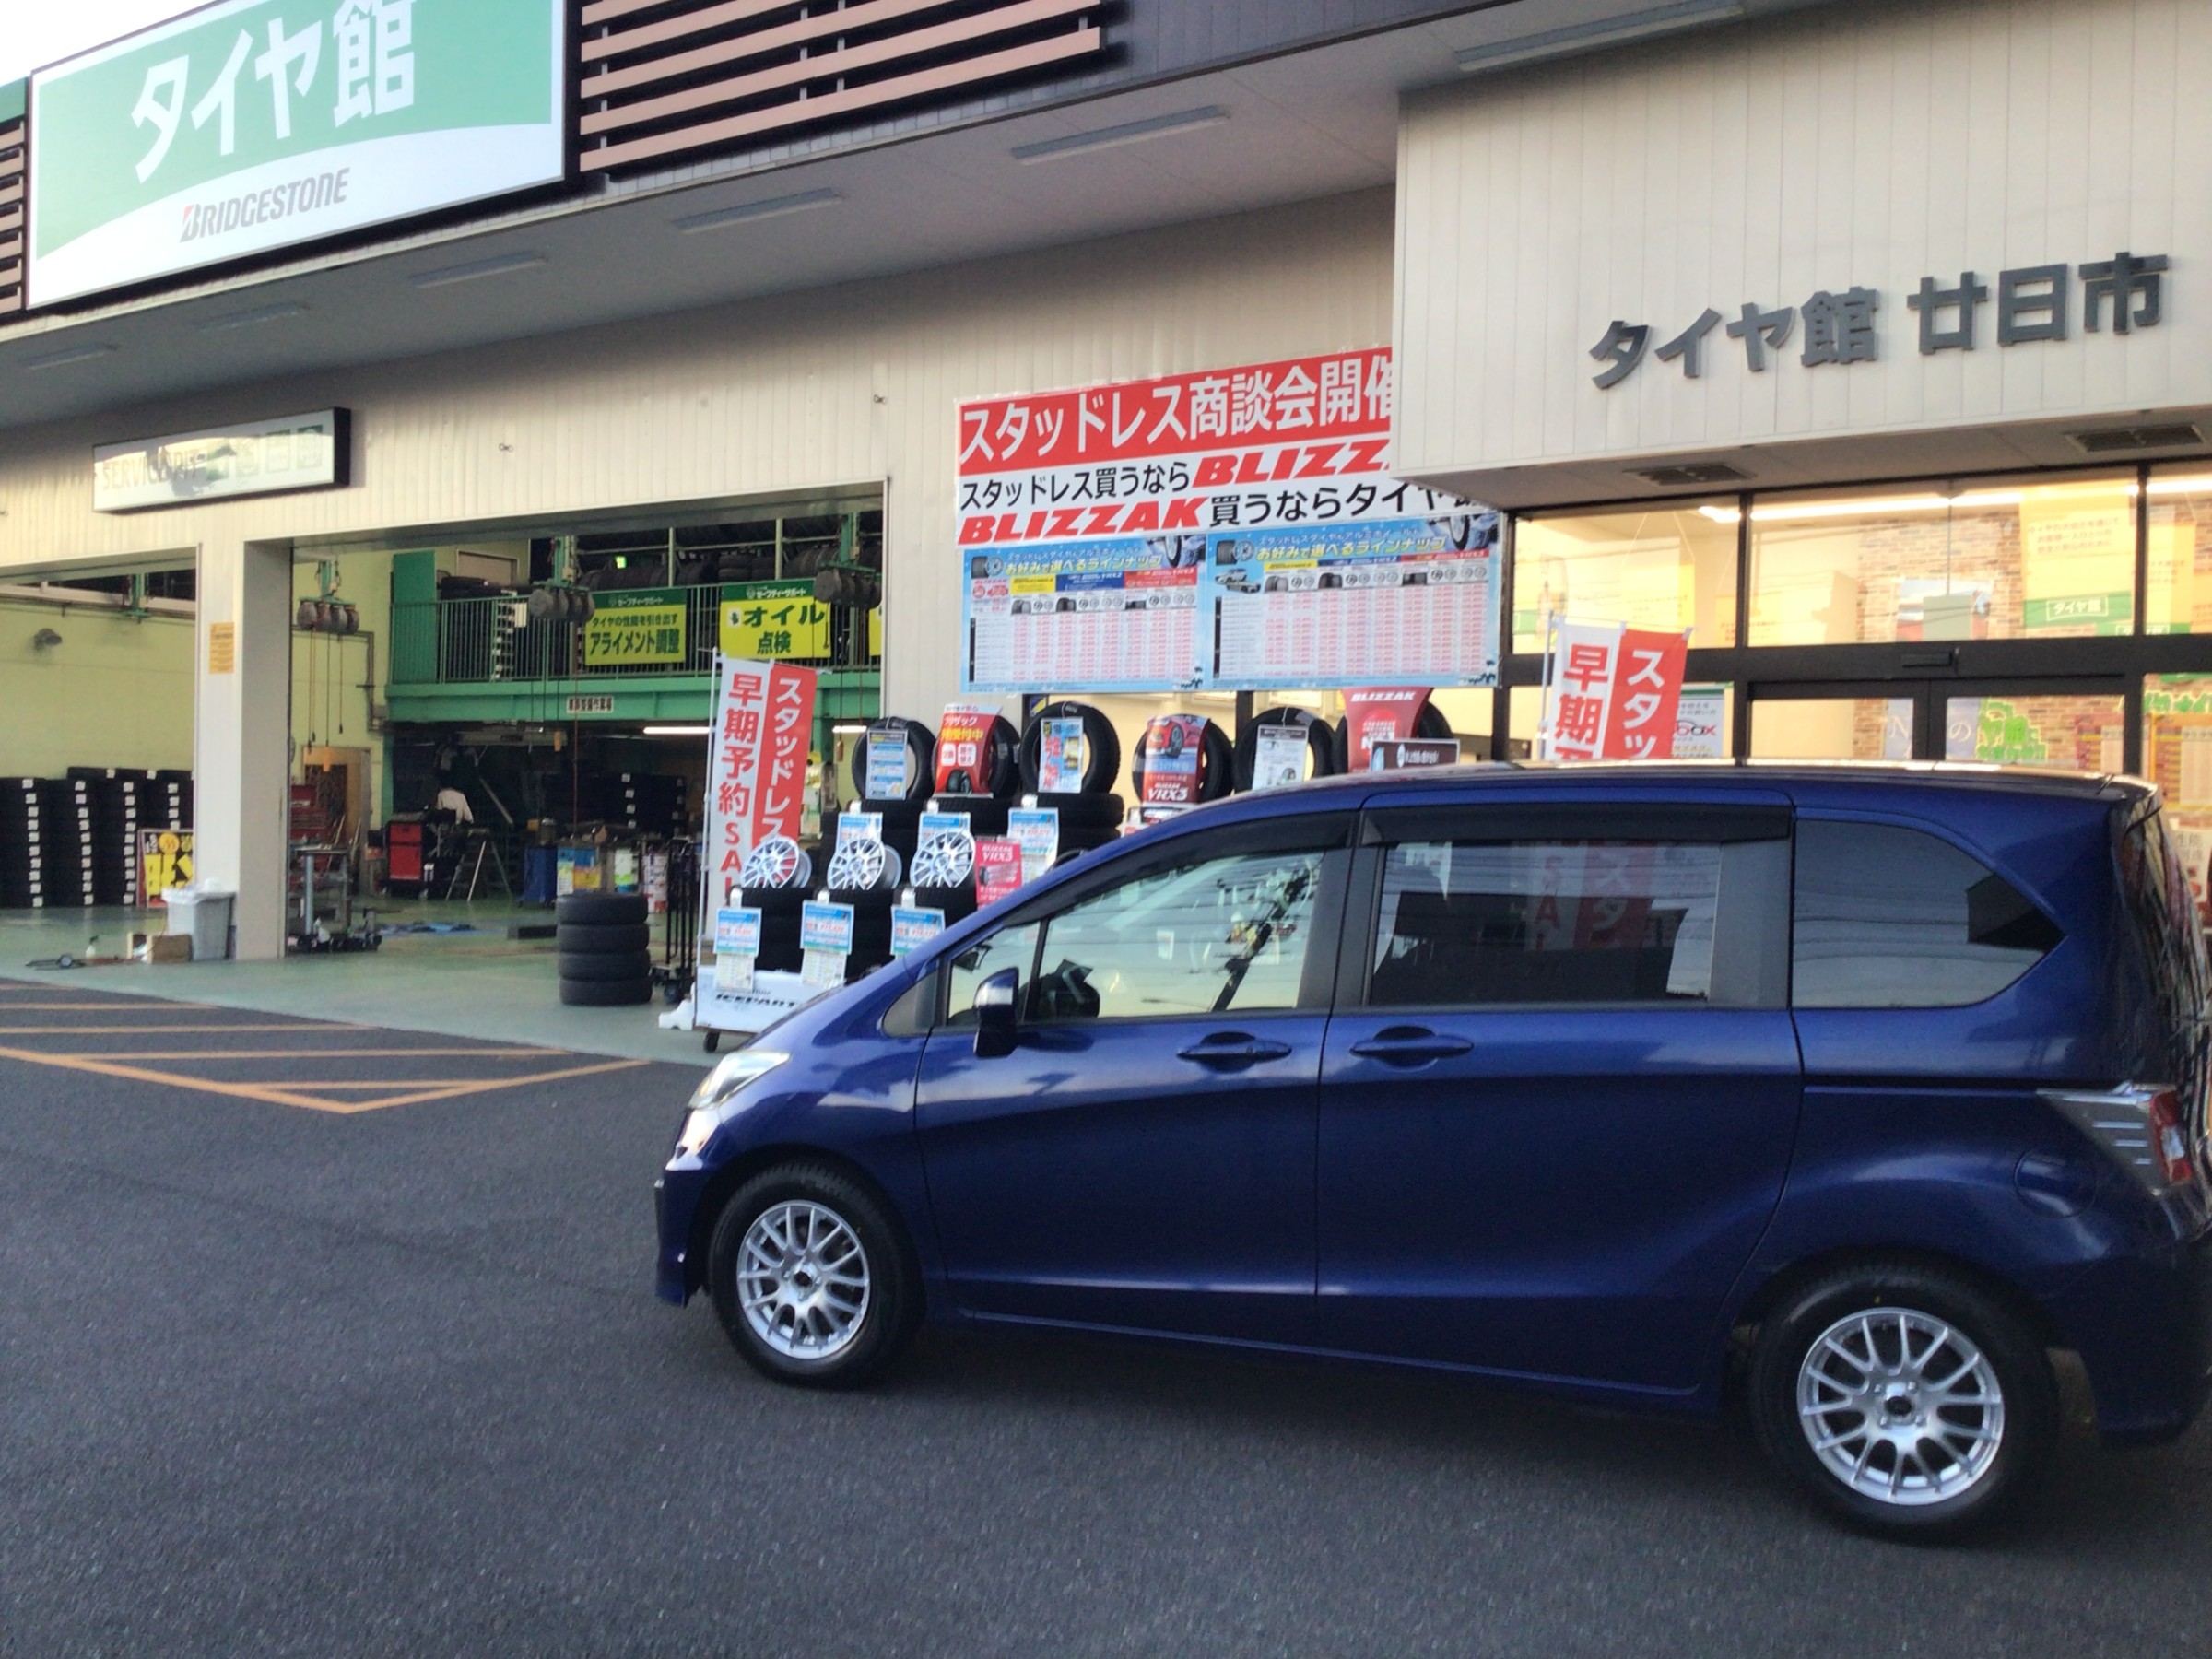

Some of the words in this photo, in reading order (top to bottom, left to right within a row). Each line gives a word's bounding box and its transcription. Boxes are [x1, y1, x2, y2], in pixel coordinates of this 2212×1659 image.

[132, 0, 416, 183] タイヤ館
[180, 167, 350, 243] BRIDGESTONE
[1589, 287, 1878, 390] タイヤ館
[1907, 251, 2169, 356] 廿日市
[961, 461, 1190, 511] スタッドレス買うなら
[1192, 439, 1391, 488] BLIZZ
[958, 497, 1209, 546] BLIZZAK
[1209, 482, 1472, 527] 買うならタイヤ
[1255, 535, 1447, 560] お好みで選べるラインナップ
[743, 604, 826, 628] オイル
[2053, 599, 2102, 615] タイヤ館
[590, 629, 680, 656] アライメント調整
[757, 630, 792, 655] 点検
[1350, 691, 1417, 702] BLIZZAK
[1147, 787, 1189, 801] VRX3
[982, 851, 1014, 863] VRX3
[715, 994, 795, 1008] ICEPART
